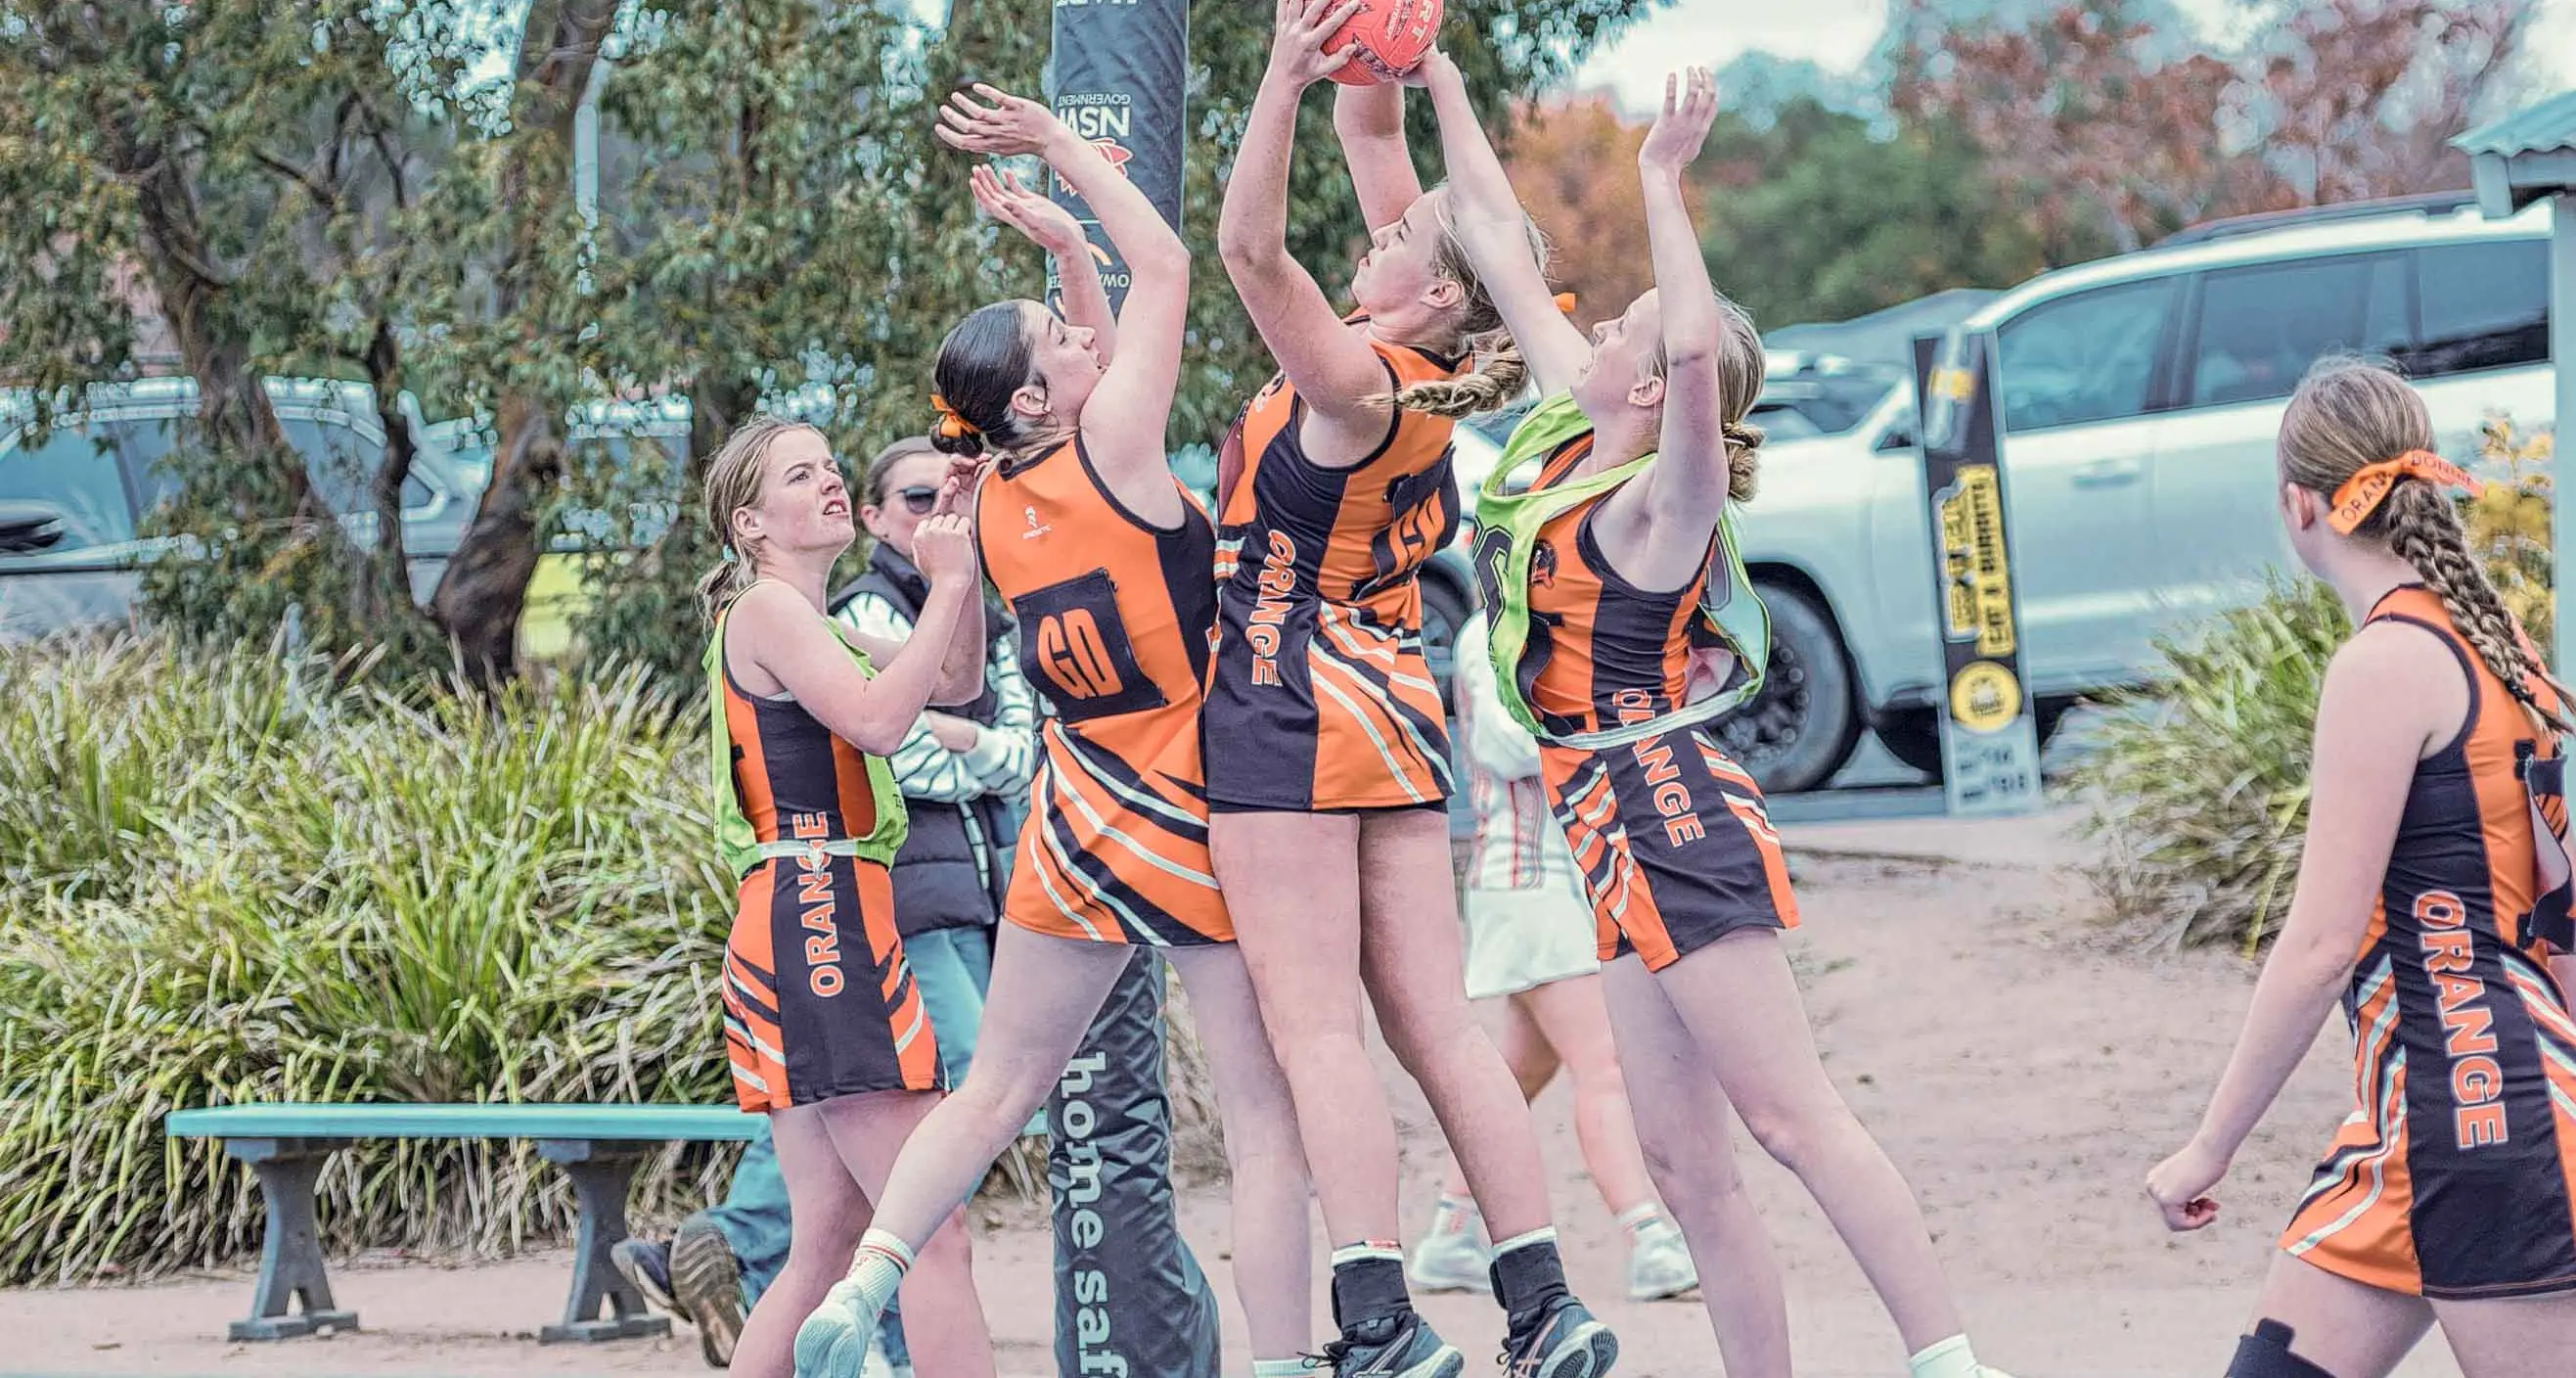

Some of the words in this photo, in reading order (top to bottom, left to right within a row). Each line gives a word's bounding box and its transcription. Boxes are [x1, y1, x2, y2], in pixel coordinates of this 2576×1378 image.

[1058, 93, 1131, 107] GOVERNMENT
[1059, 105, 1131, 137] NSW
[1038, 608, 1123, 700] GD
[2412, 891, 2508, 1150] ORANGE
[1061, 1051, 1107, 1249] home
[1074, 1269, 1129, 1378] saf
